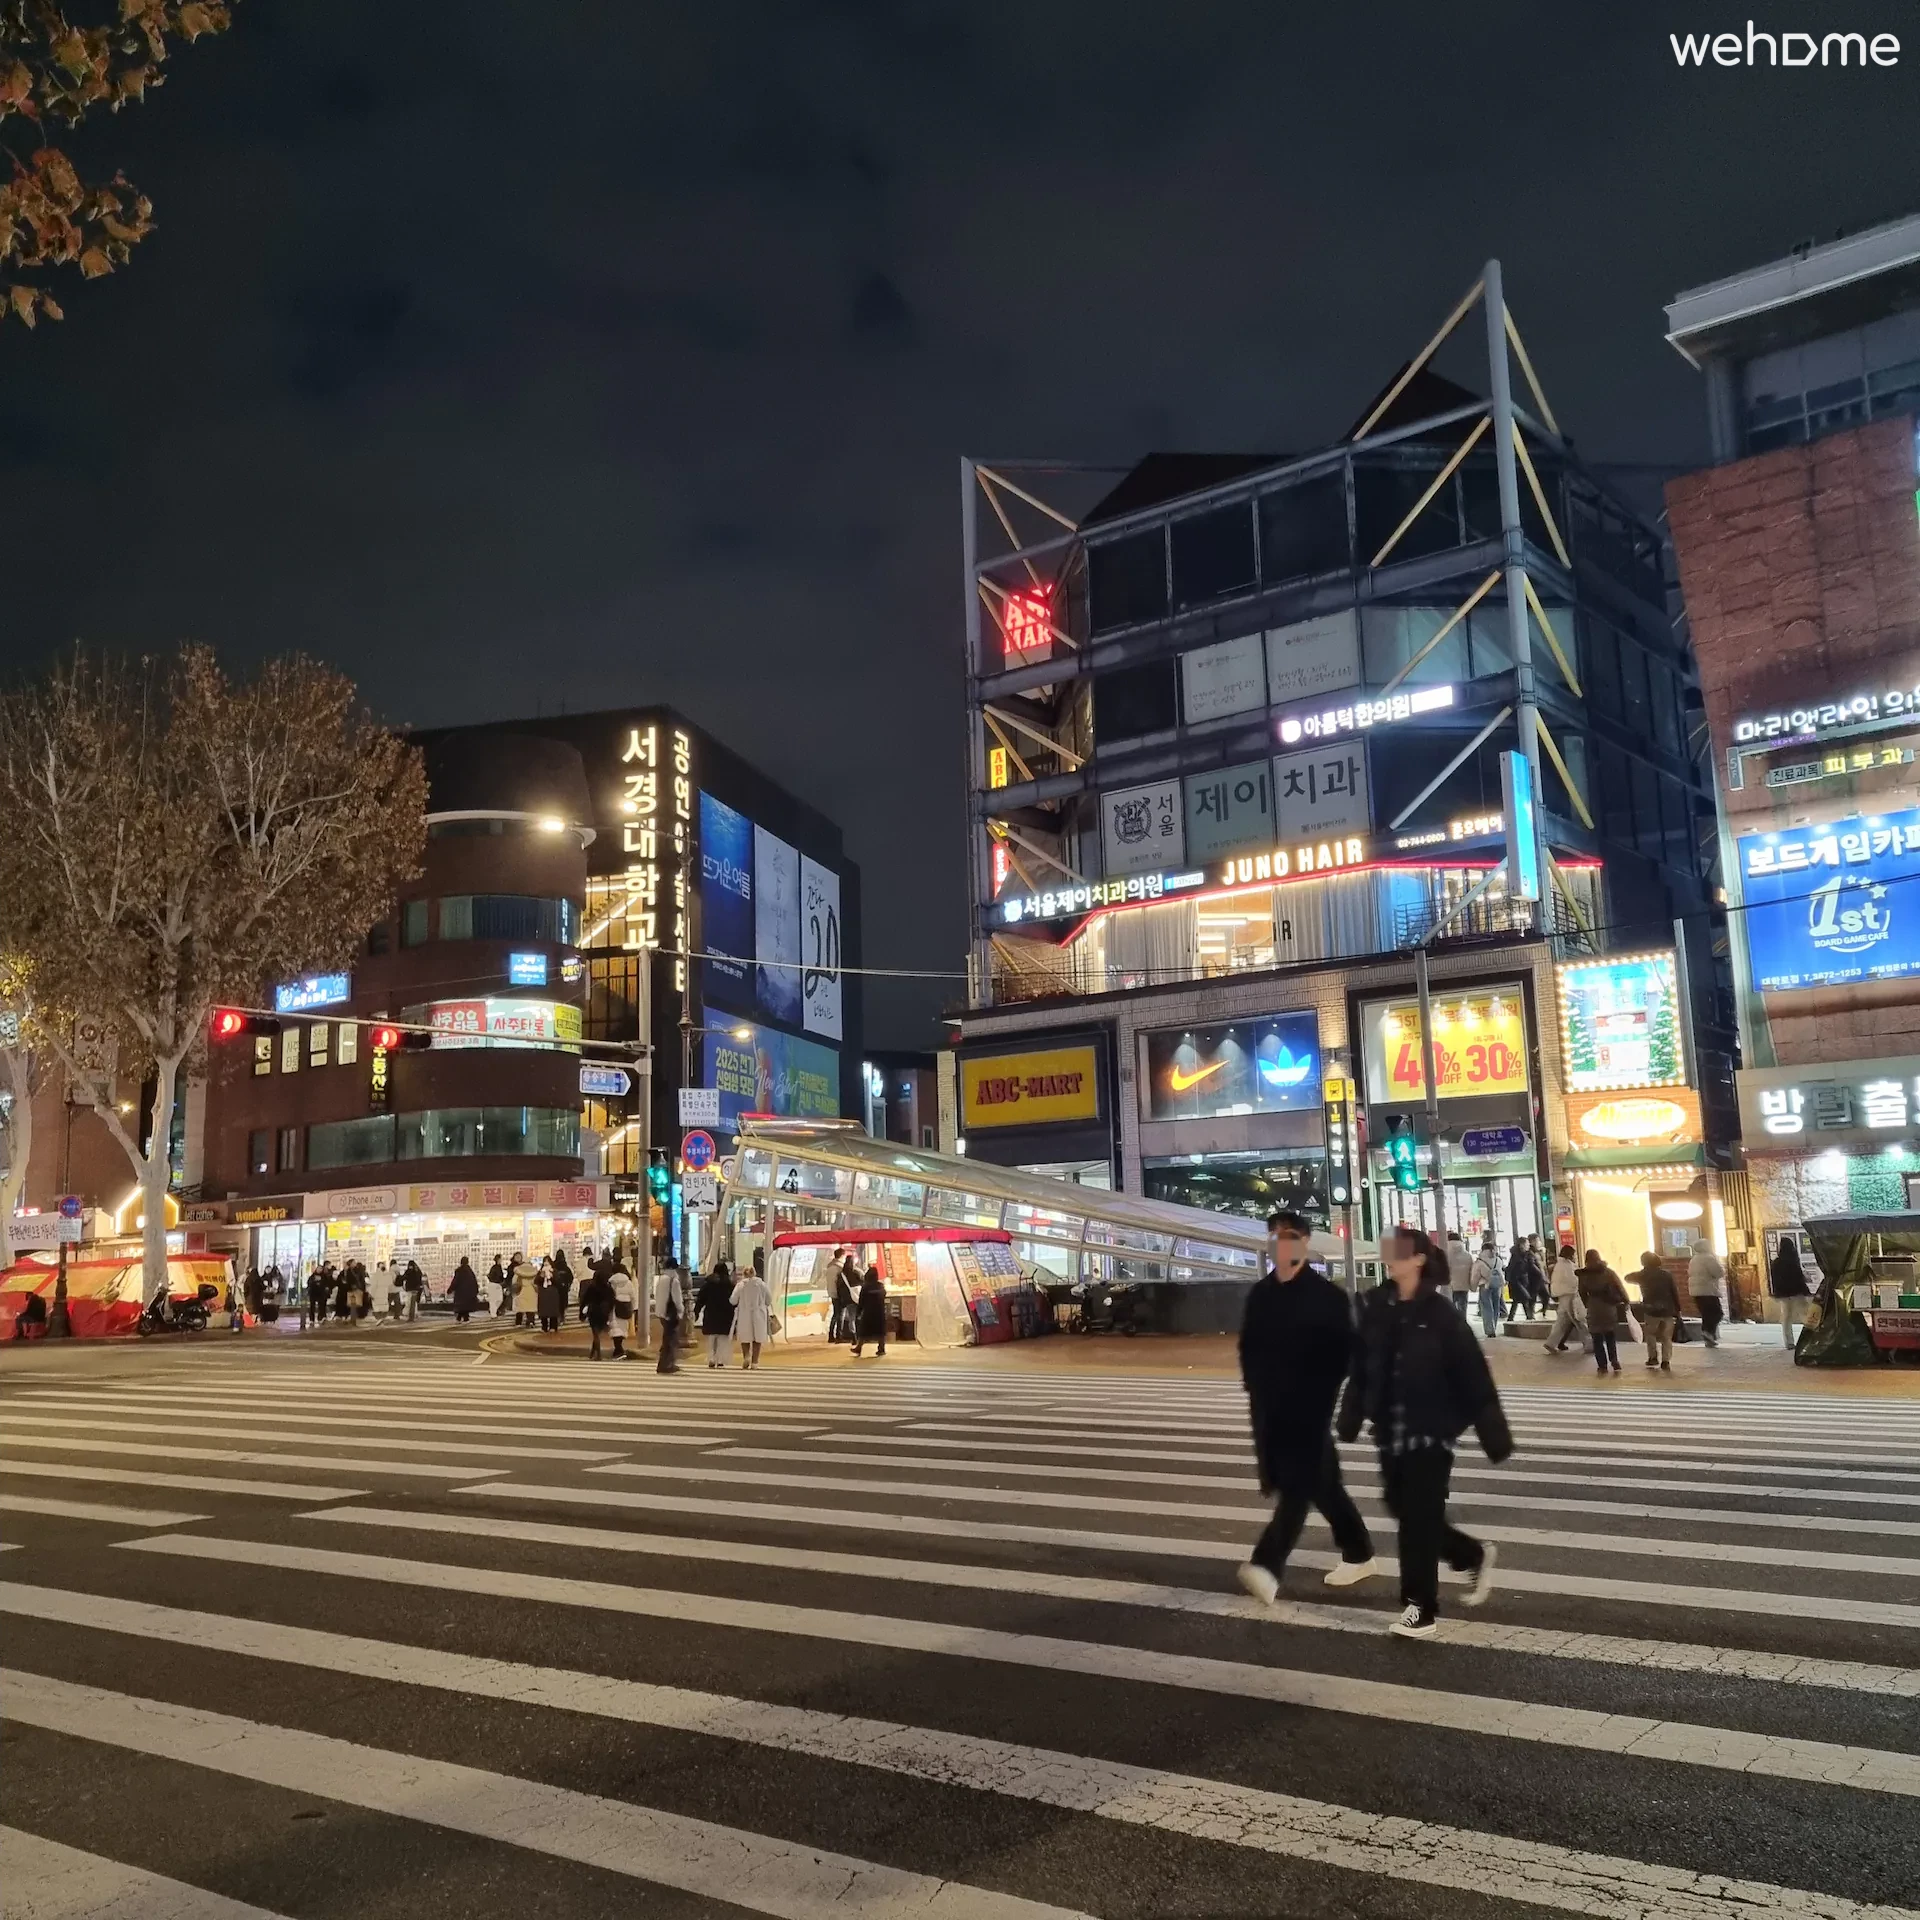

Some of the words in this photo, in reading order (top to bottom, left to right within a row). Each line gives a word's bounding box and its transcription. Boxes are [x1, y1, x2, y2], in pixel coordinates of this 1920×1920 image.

[1283, 756, 1360, 805] 치과
[1773, 765, 1819, 782] 진료과목
[1825, 748, 1904, 773] 피부과
[1157, 793, 1175, 837] 서울
[1195, 774, 1267, 822] 제이
[621, 726, 660, 951] 서경대학교
[703, 854, 732, 891] 뜨거운
[1222, 850, 1289, 886] JUNO
[1298, 838, 1363, 873] HAIR
[1023, 873, 1163, 917] 서울제이치과의원
[1809, 876, 1881, 937] 1st
[1814, 934, 1842, 948] BOARD
[1843, 933, 1867, 944] GAME
[1867, 931, 1889, 941] CAFE
[716, 1046, 739, 1072] 2025
[1444, 1073, 1462, 1085] OFF
[1508, 1069, 1524, 1079] OFF
[975, 1072, 1083, 1106] ABC-MART
[1759, 1079, 1920, 1135] 방탈출
[685, 1177, 715, 1188] 견인지역
[235, 1206, 288, 1222] wonderbra
